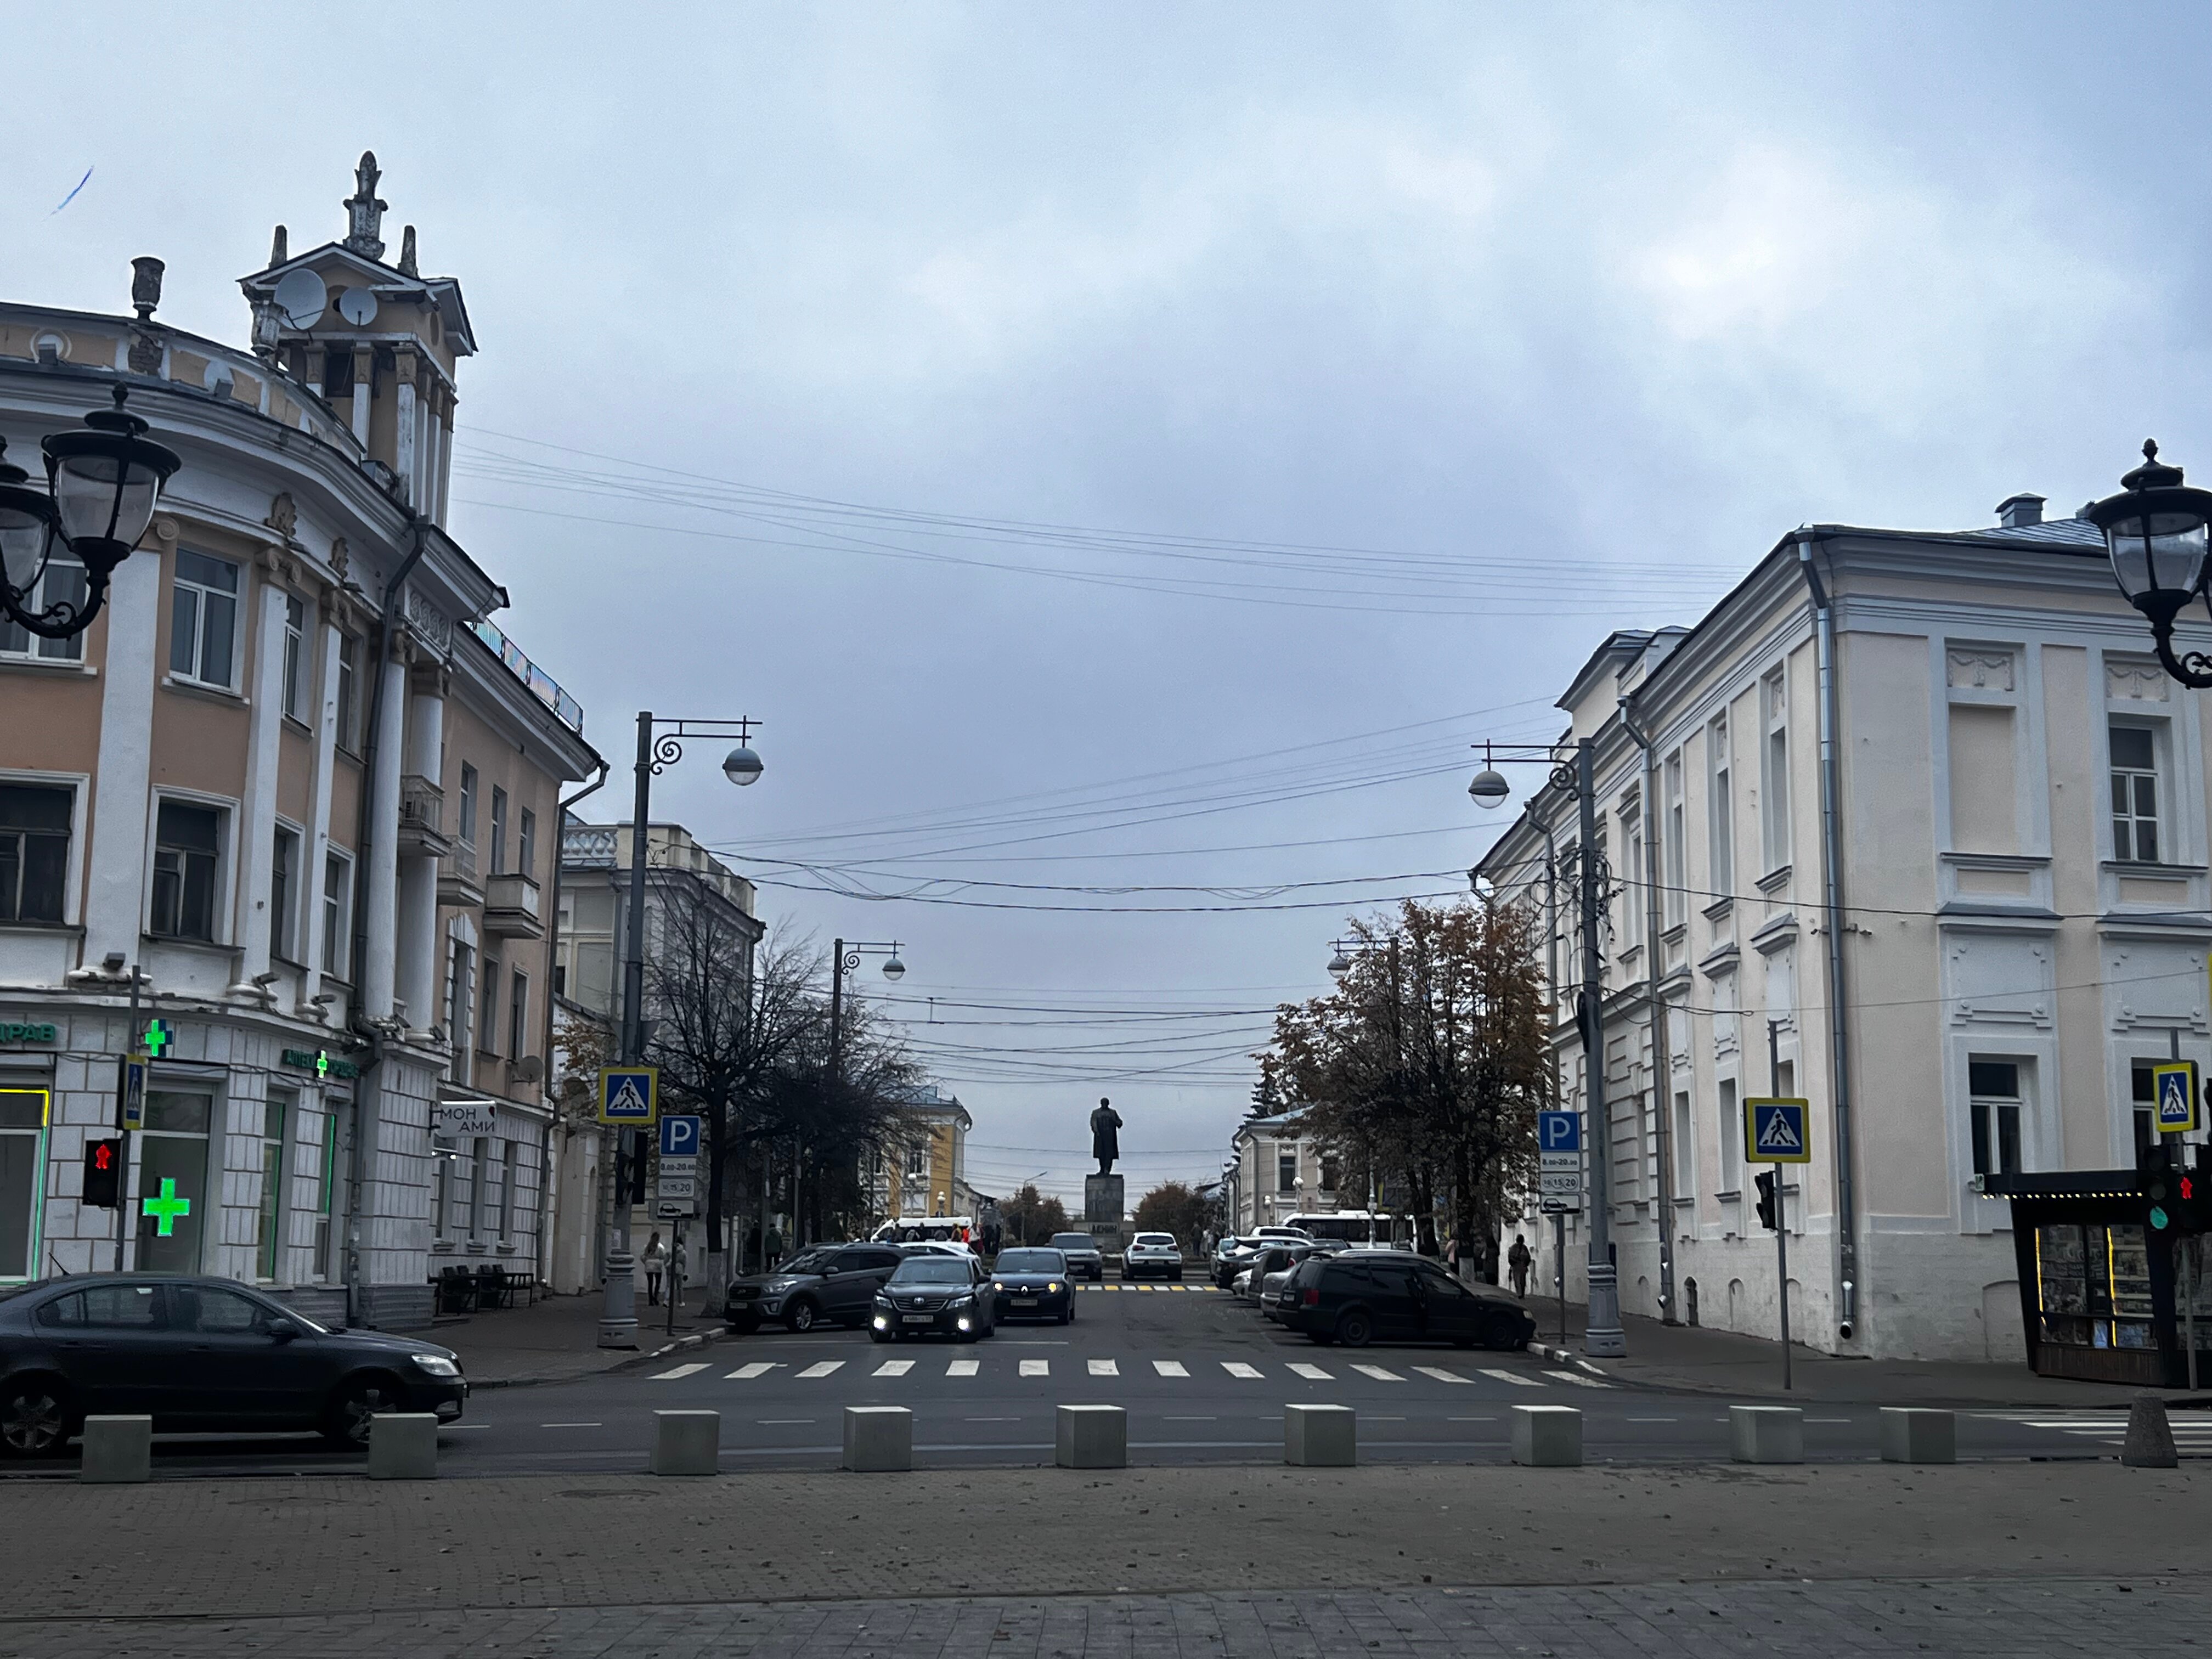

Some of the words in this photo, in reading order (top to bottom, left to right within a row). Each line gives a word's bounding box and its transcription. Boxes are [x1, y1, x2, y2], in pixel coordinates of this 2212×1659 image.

[440, 1108, 476, 1119] МОН
[458, 1121, 494, 1132] АМИ
[680, 1183, 691, 1192] 20
[1565, 1178, 1576, 1187] 20
